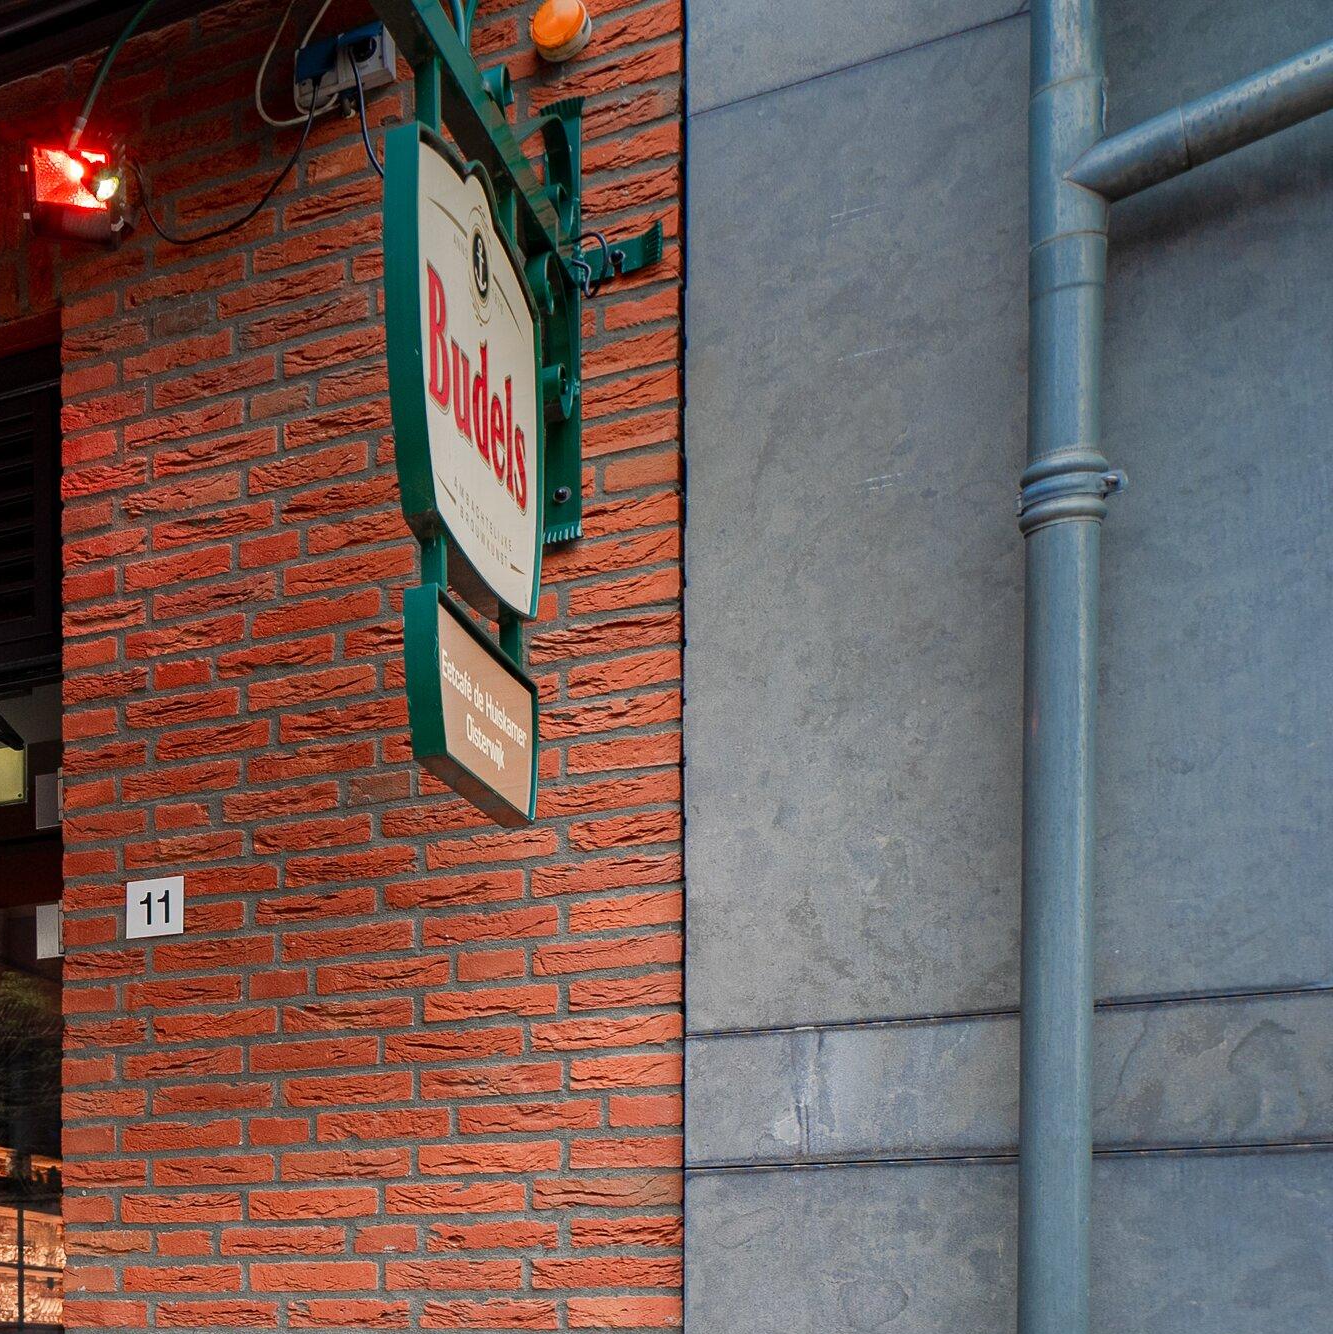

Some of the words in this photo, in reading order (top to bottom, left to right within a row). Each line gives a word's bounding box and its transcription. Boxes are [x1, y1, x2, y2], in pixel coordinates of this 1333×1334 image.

[425, 257, 528, 517] Budels
[441, 648, 473, 702] Eetcafé
[473, 682, 484, 713] de
[485, 690, 528, 749] Huiskamer
[466, 712, 506, 771] Oisterwijk
[139, 889, 170, 926] 11
